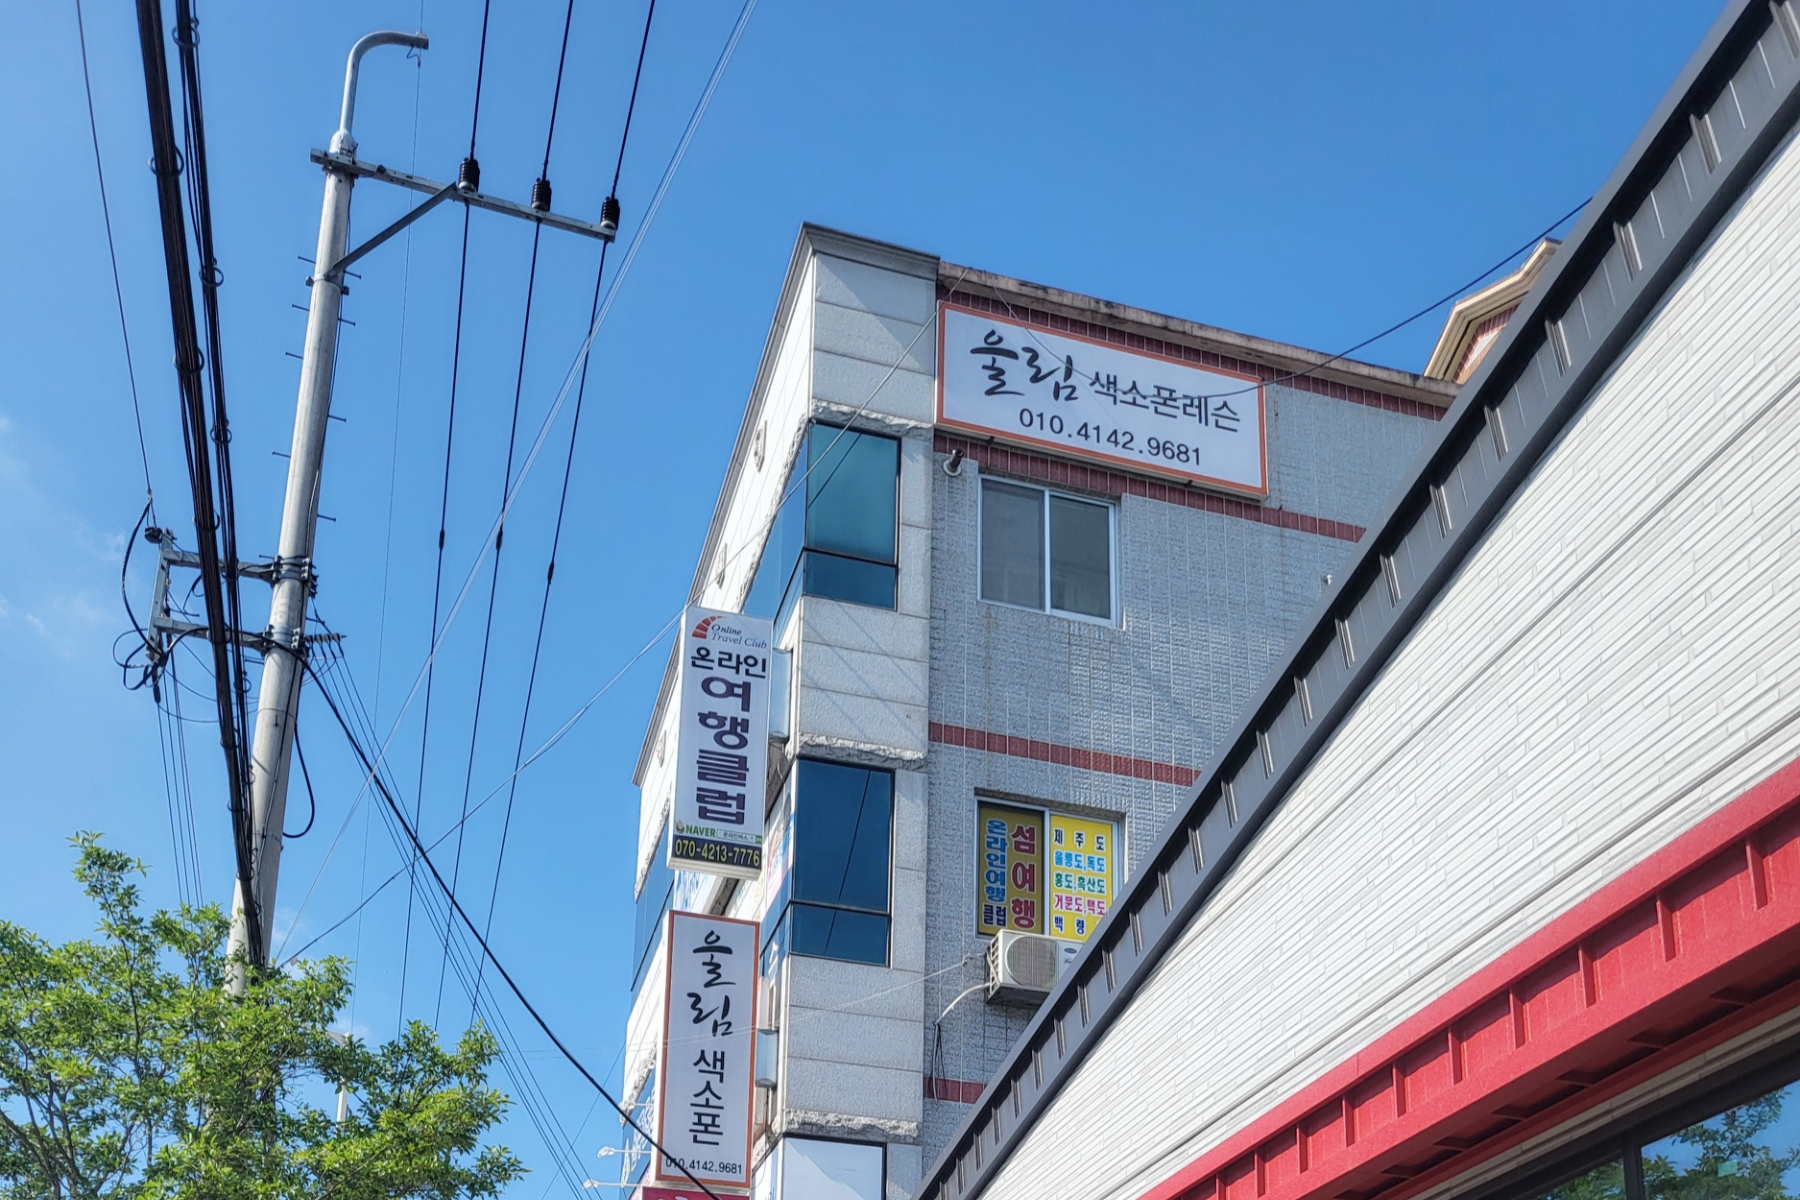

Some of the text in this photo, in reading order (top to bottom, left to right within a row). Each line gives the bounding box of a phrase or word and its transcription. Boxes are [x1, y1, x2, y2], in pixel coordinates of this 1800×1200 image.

[1089, 370, 1241, 433] 색소폰레슨
[1019, 408, 1201, 466] 010.4142.9681
[711, 623, 742, 636] Online
[712, 632, 767, 649] Travel Club
[691, 646, 767, 680] 온라인
[696, 676, 751, 825] 여행클럽
[685, 824, 716, 838] NAVER
[675, 838, 760, 867] 070-4213-7776
[1054, 873, 1105, 894] 홍도,흑산도
[688, 1049, 725, 1146] 색소폰
[665, 1157, 743, 1175] 010.4142.9681
